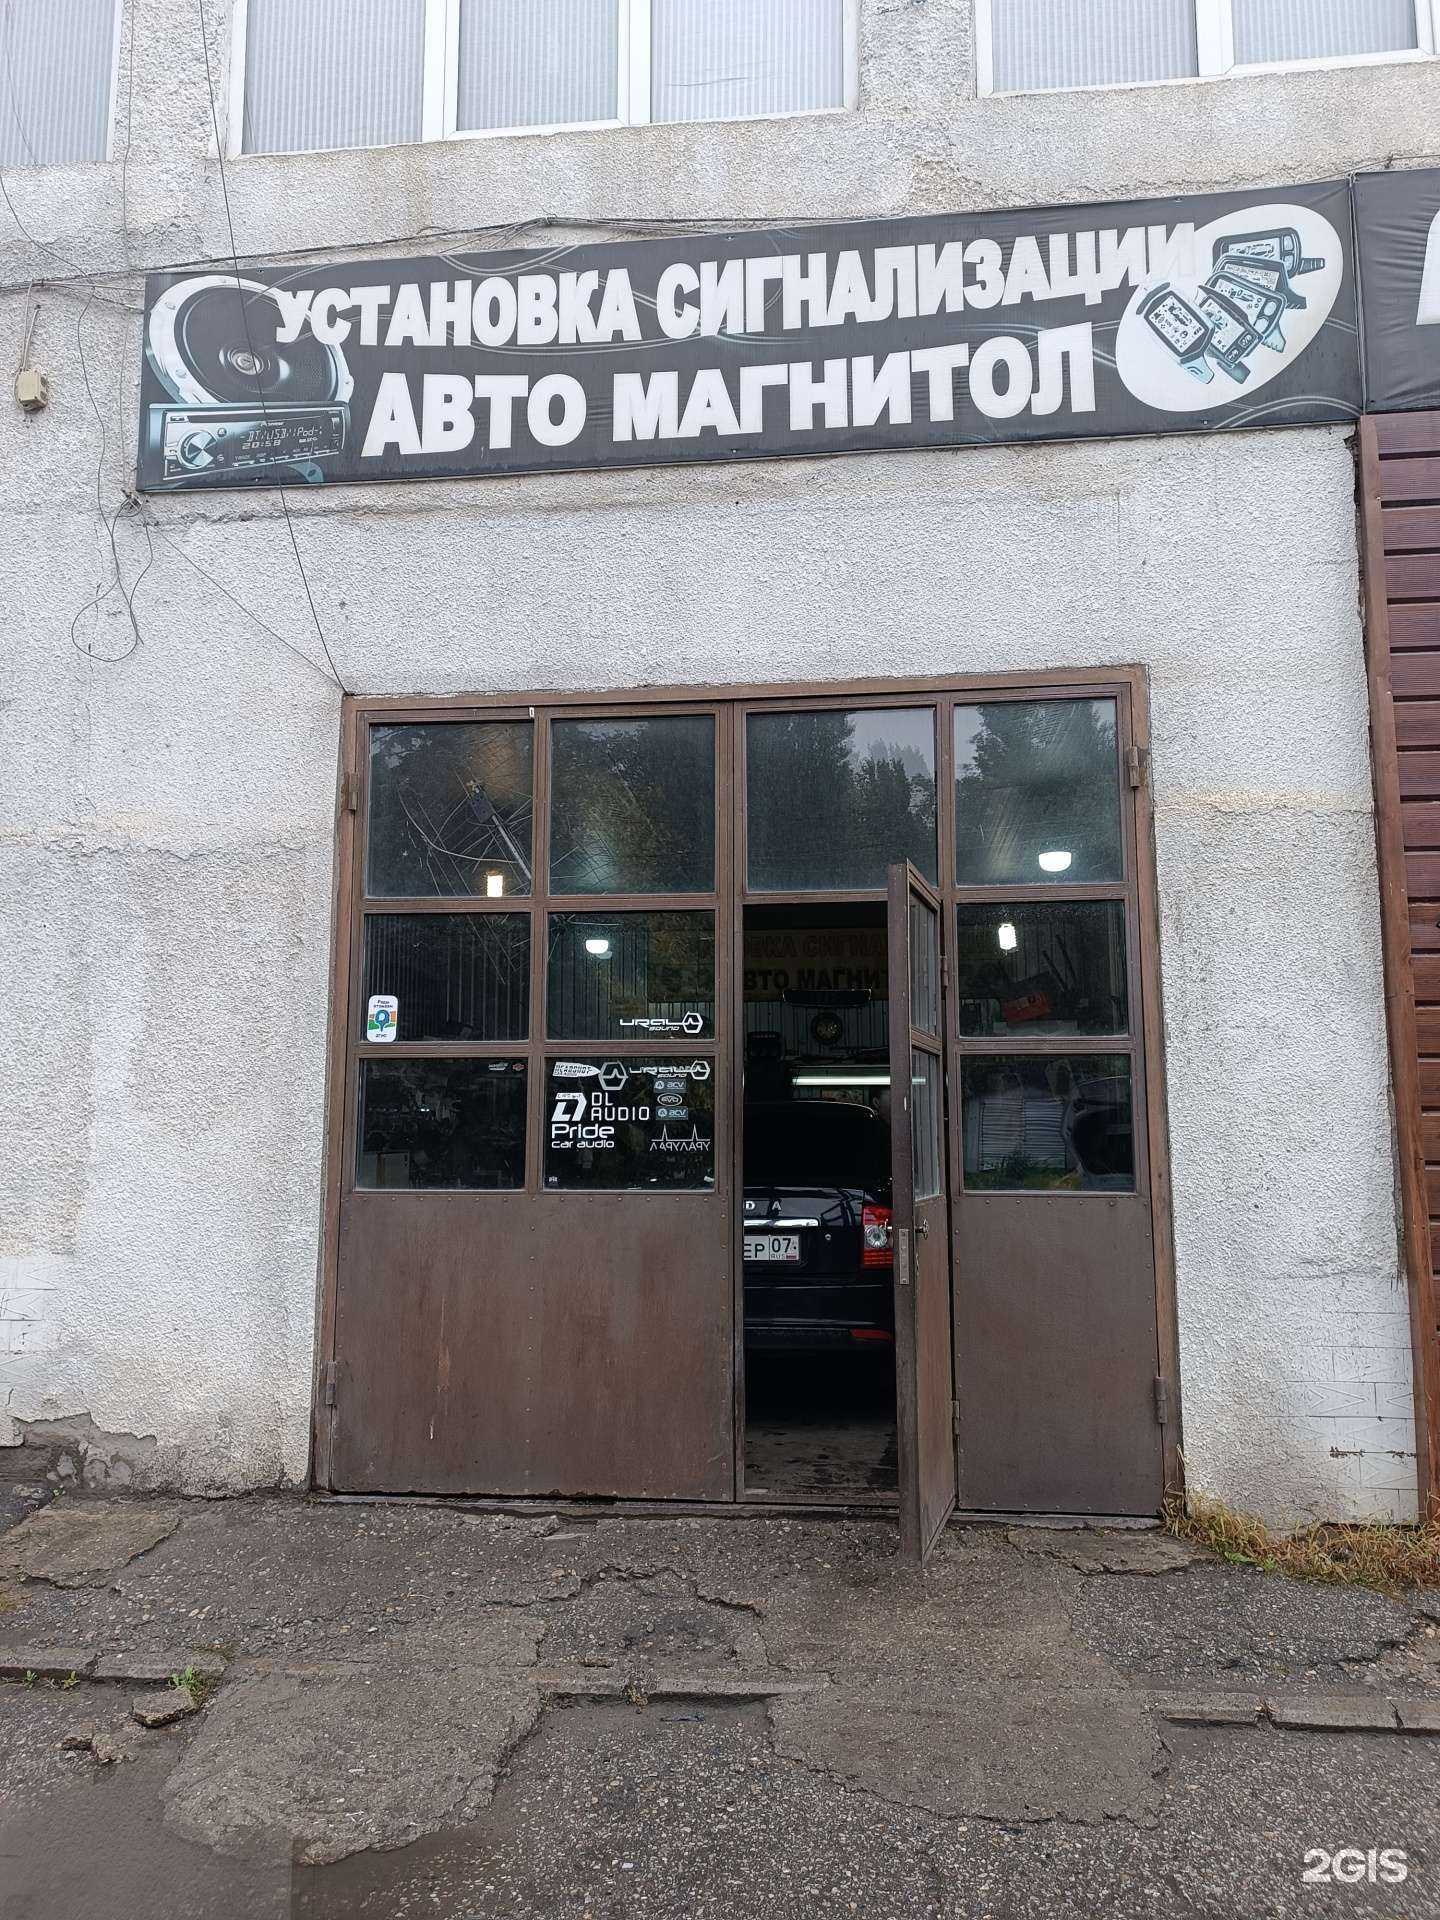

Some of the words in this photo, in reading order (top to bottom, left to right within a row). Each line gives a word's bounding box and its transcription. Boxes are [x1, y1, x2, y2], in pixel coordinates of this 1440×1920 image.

[275, 268, 642, 347] УСТАНОВКА
[656, 222, 1195, 339] СИГНАЛИЗАЦИИ
[361, 371, 587, 458] АВТО
[612, 321, 1096, 442] МАГНИТОЛ
[591, 1092, 614, 1106] DL
[590, 1106, 650, 1121] AUDIO
[551, 1123, 615, 1139] Pride
[551, 1141, 573, 1149] car
[576, 1139, 615, 1149] audio
[771, 1238, 792, 1253] 07
